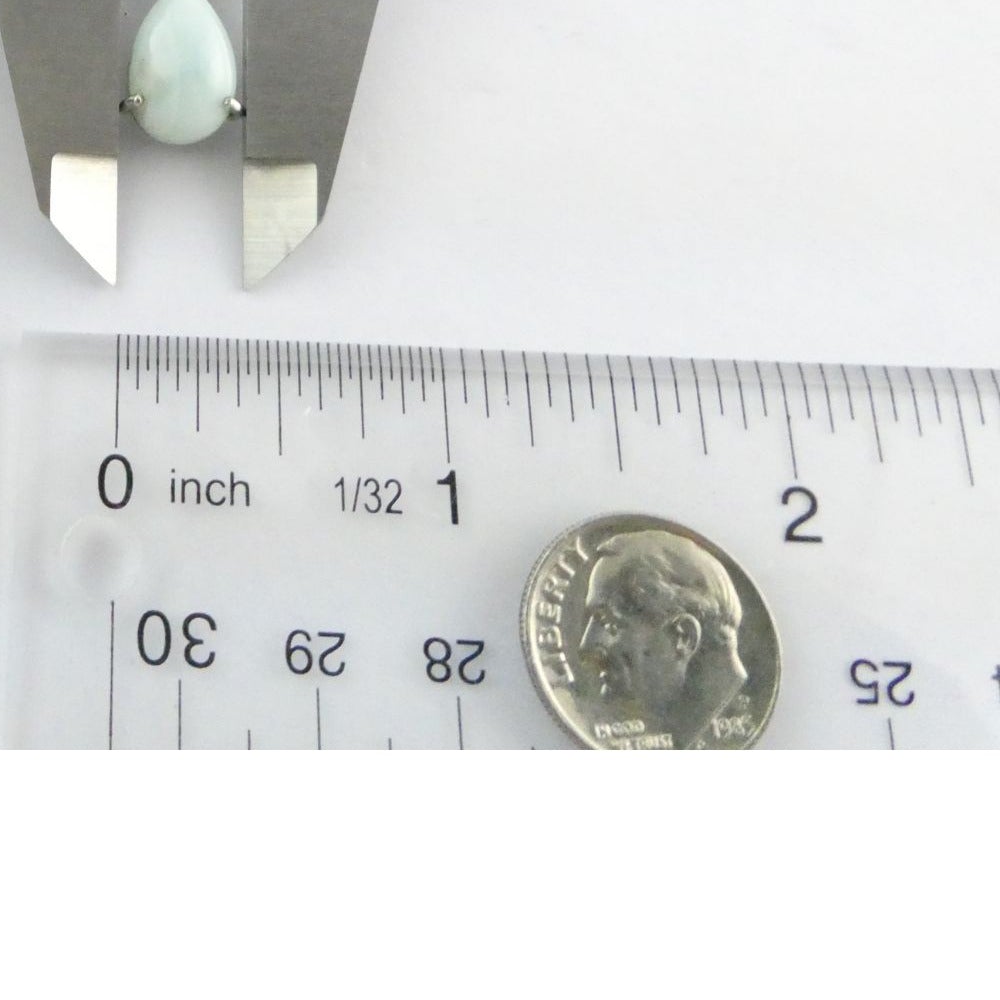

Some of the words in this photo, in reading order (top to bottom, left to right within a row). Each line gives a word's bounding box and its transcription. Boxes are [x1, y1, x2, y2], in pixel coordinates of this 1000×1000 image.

[97, 453, 134, 510] 0
[170, 468, 251, 507] inch
[334, 476, 404, 515] 1/32
[436, 469, 460, 526] 1
[780, 485, 825, 545] 2
[536, 534, 590, 684] LIBERTY
[136, 609, 218, 670] 30
[284, 628, 346, 678] 29
[423, 636, 487, 686] 28
[849, 657, 916, 708] 25
